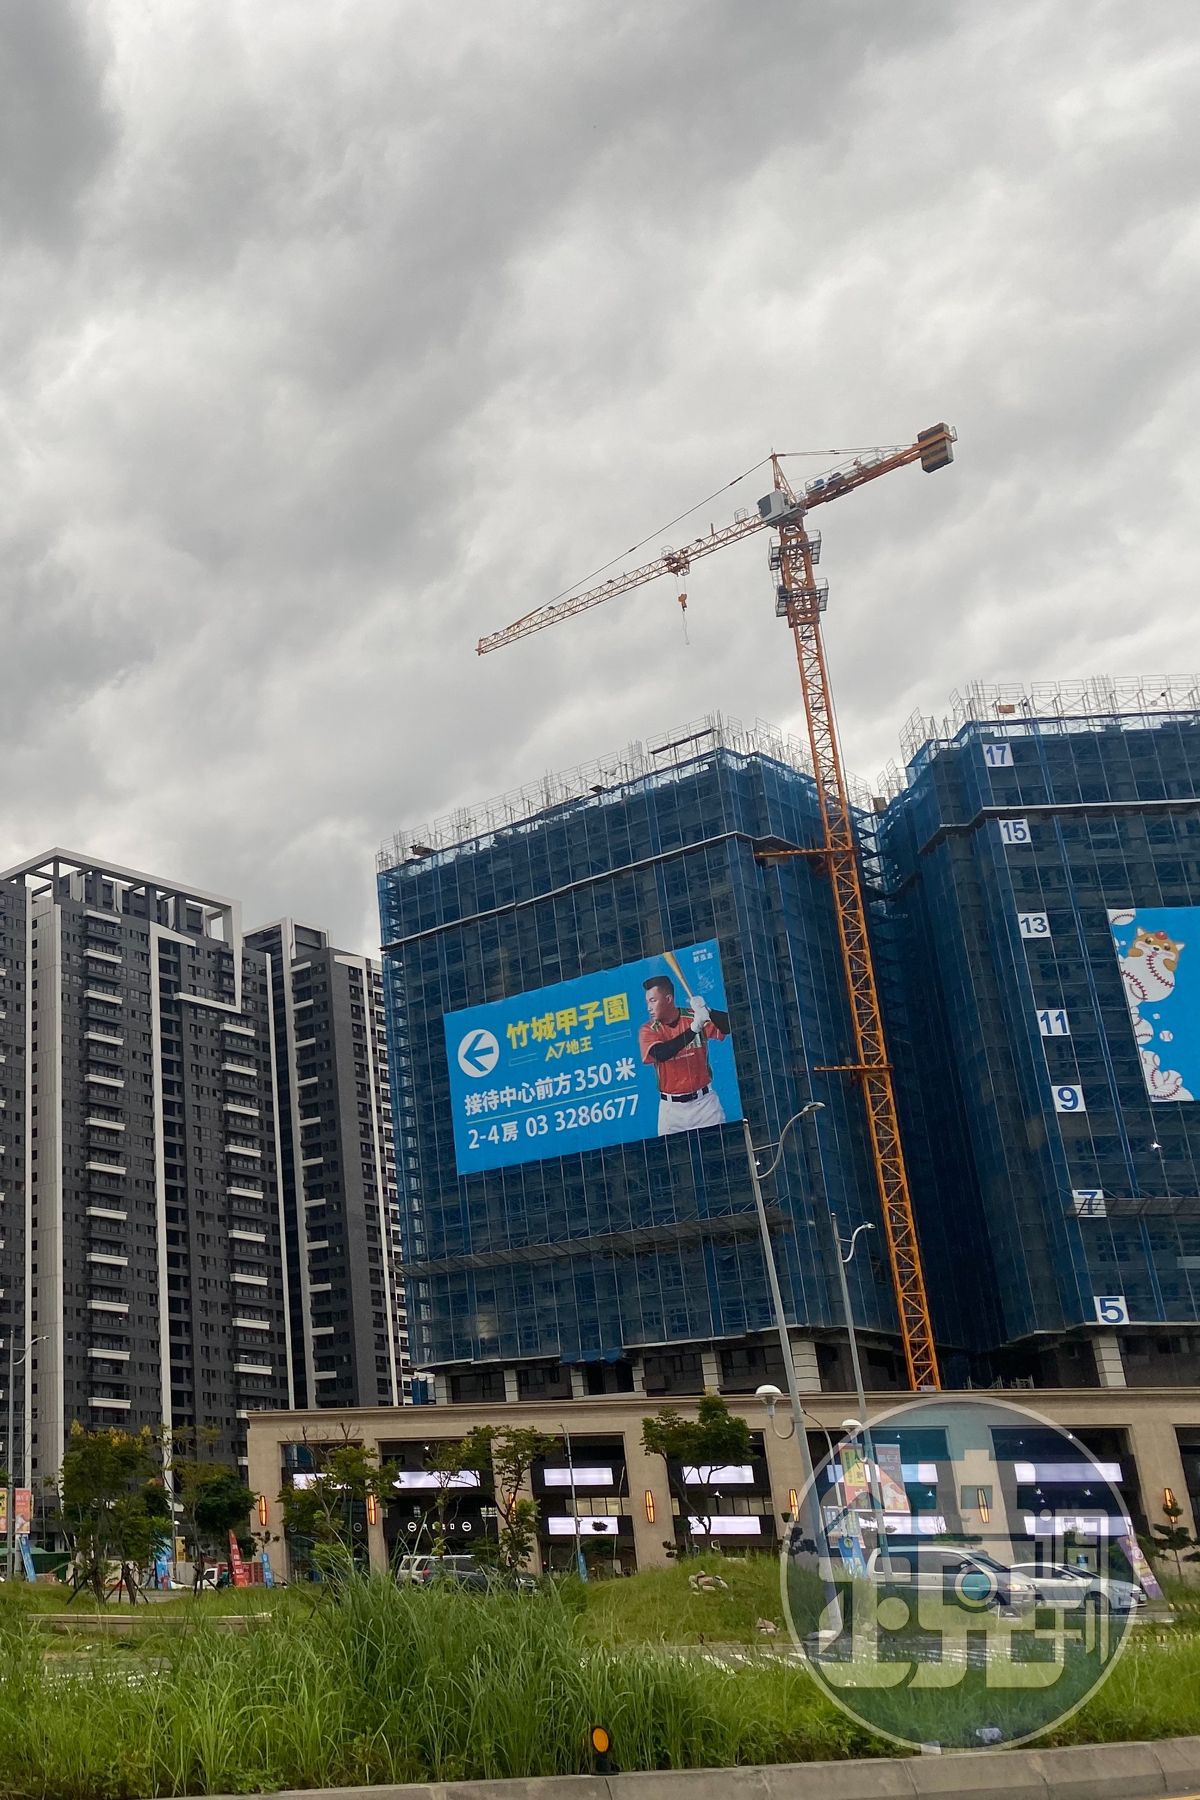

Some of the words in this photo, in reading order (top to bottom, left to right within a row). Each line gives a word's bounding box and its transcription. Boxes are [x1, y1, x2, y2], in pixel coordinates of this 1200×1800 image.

[986, 745, 1007, 766] 17
[1002, 821, 1027, 842] 15
[1020, 916, 1047, 934] 13
[506, 992, 630, 1049] 竹城甲子園
[1040, 1010, 1068, 1034] 11
[545, 1036, 593, 1061] A7地王
[1057, 1086, 1079, 1110] 9
[468, 1120, 518, 1149] 2-4房
[525, 1115, 549, 1138] 03
[554, 1094, 639, 1132] 3286677
[1077, 1191, 1098, 1215] 7
[1099, 1298, 1125, 1323] 5
